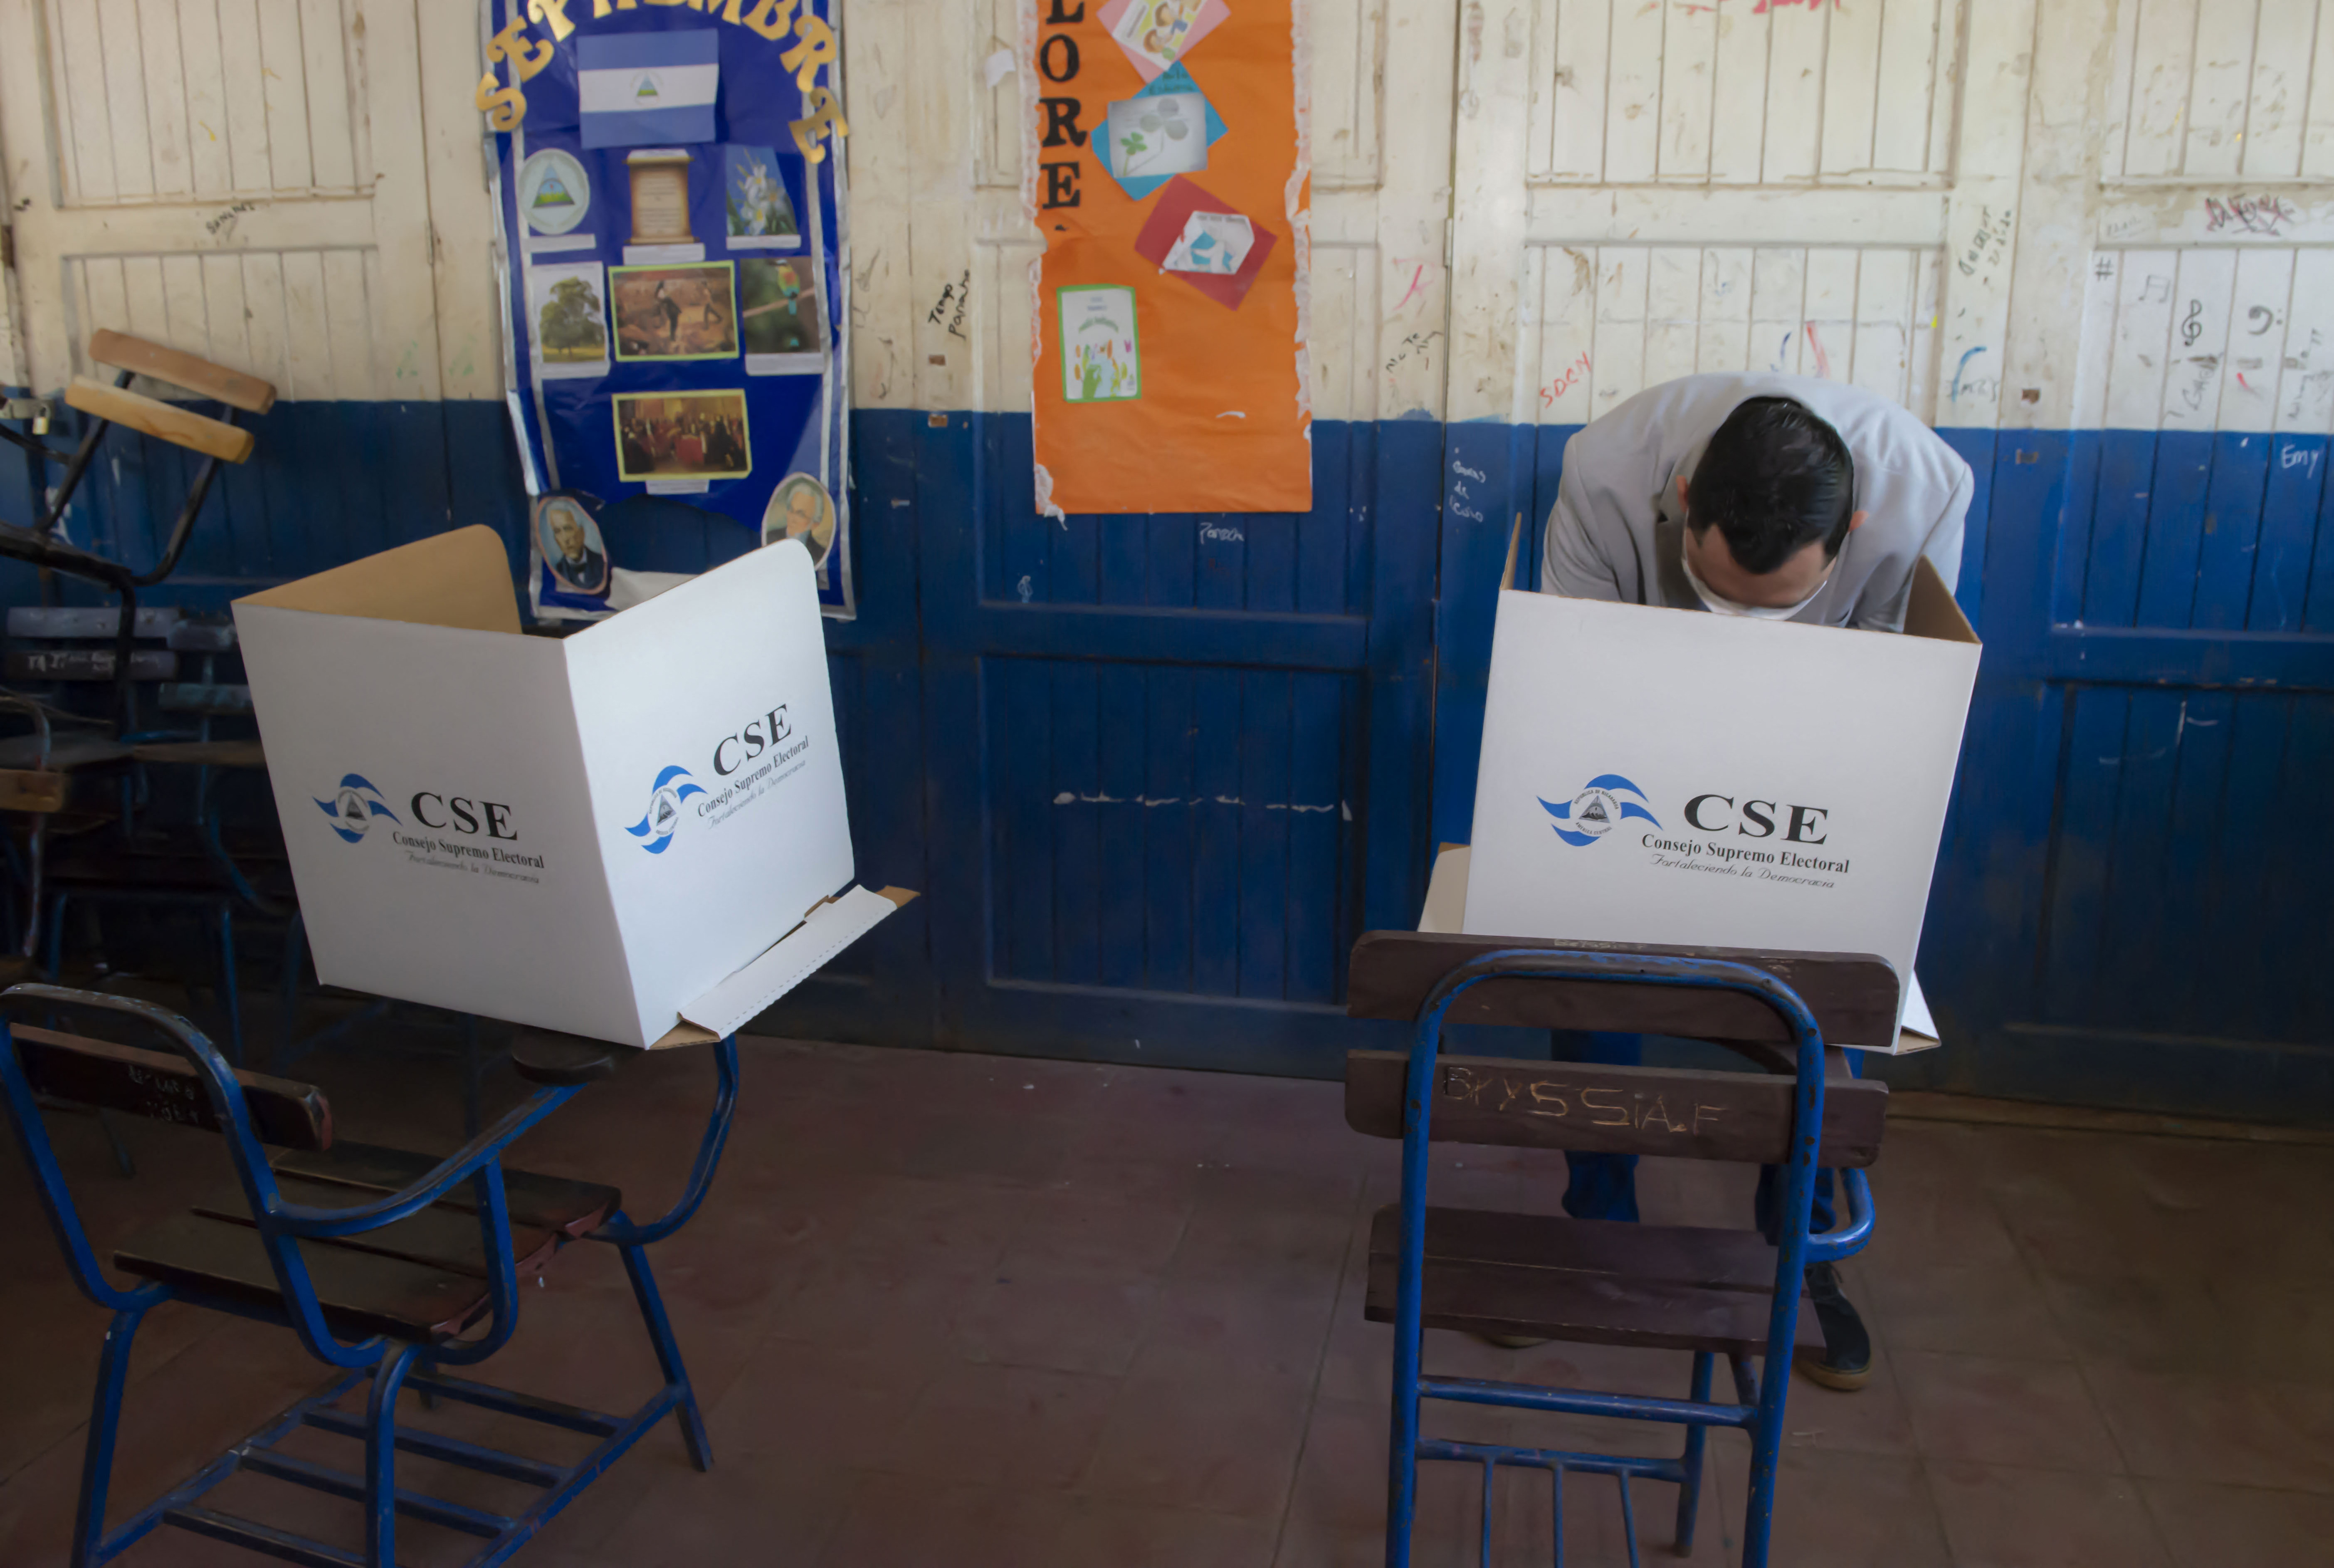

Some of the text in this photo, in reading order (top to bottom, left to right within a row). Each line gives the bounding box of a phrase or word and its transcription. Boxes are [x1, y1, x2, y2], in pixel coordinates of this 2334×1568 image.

[476, 0, 849, 164] SEPBRE
[714, 704, 791, 776] CSE
[698, 788, 733, 817] Consejo
[734, 763, 771, 793] Supremo
[773, 735, 808, 768] Electoral
[411, 792, 518, 840] CSE
[1684, 794, 1828, 844] CSE
[393, 831, 544, 868] Consejo Supremo Electoral
[1642, 834, 1850, 873] Consejo Supremo Electoral
[1650, 854, 1835, 888] Fortaleciendo la Democracia
